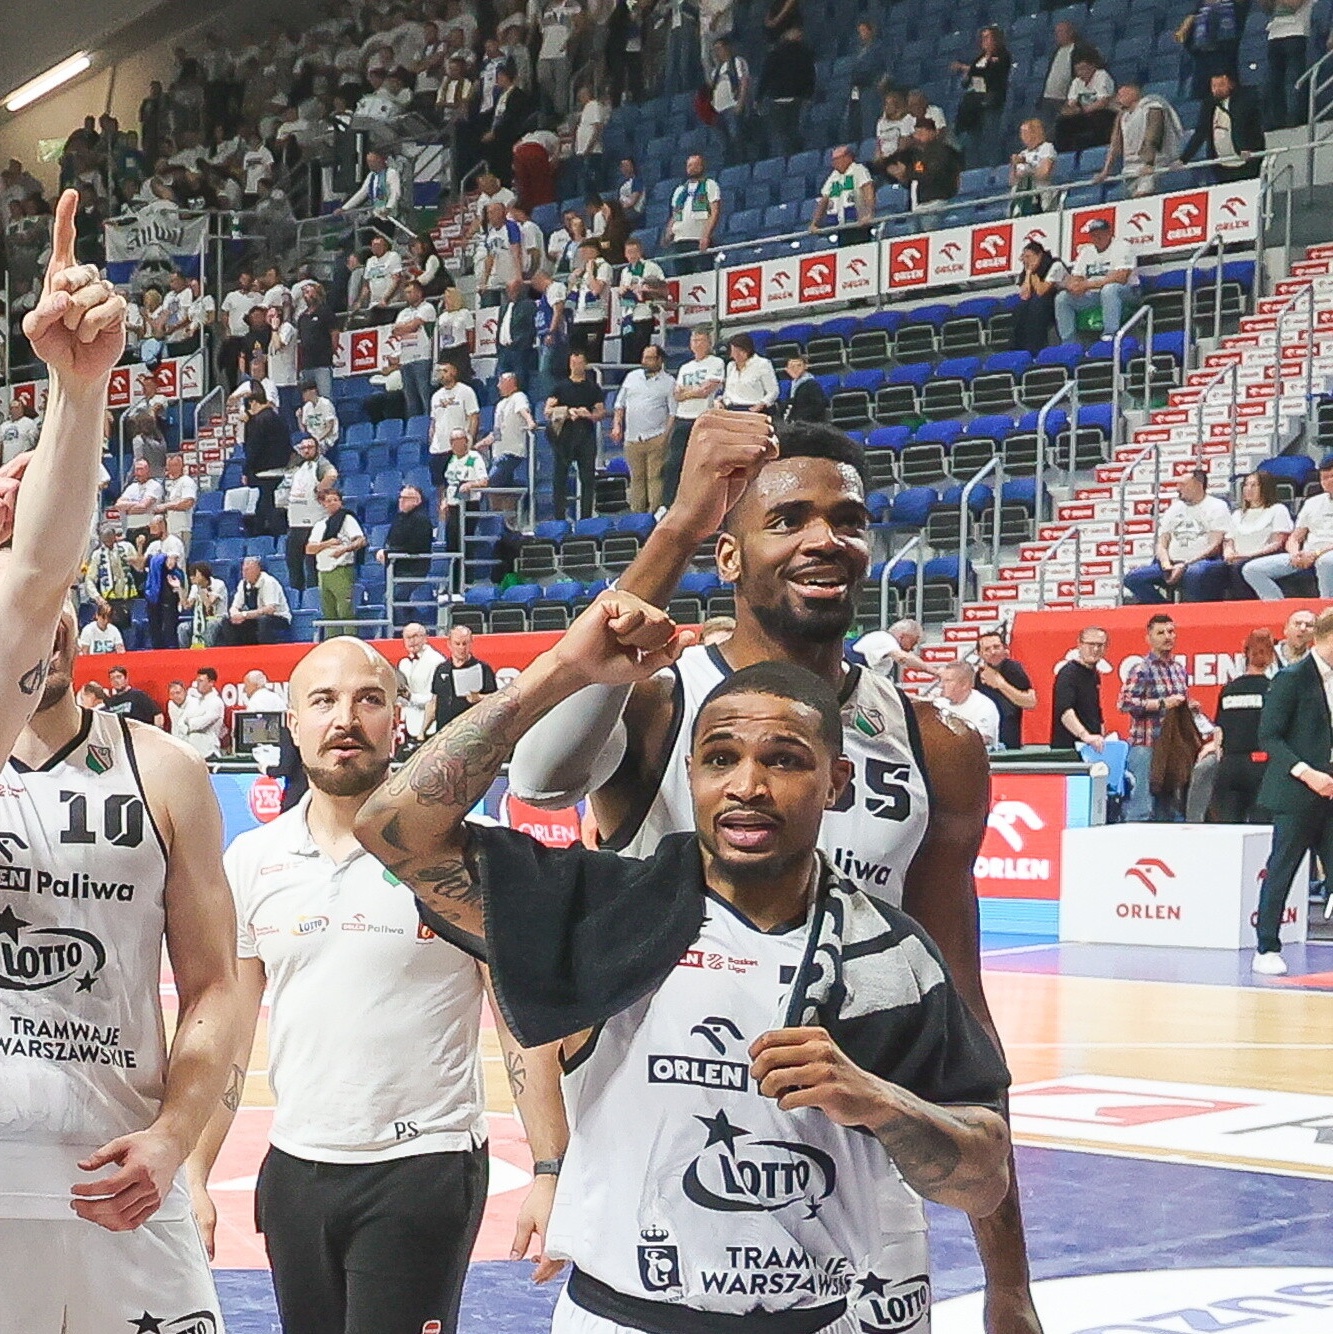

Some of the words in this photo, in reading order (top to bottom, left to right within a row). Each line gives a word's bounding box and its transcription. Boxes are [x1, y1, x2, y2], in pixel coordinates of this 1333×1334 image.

[59, 790, 145, 849] 10
[518, 821, 576, 844] ORLEN
[835, 847, 892, 886] liwa
[974, 856, 1050, 881] ORLEN
[36, 869, 136, 902] Paliwa
[1116, 903, 1182, 921] ORLEN
[1250, 906, 1298, 929] OEN
[298, 919, 323, 933] LOTTO
[367, 924, 405, 935] Paliwa
[1, 936, 83, 977] LOTTO
[727, 956, 760, 967] Basket
[727, 965, 747, 974] Liga
[10, 1016, 121, 1047] TRAMWAJE
[652, 1058, 744, 1088] ORLEN
[394, 1121, 420, 1140] PS
[719, 1153, 811, 1199] LOTTO
[869, 1283, 929, 1326] LOTTO
